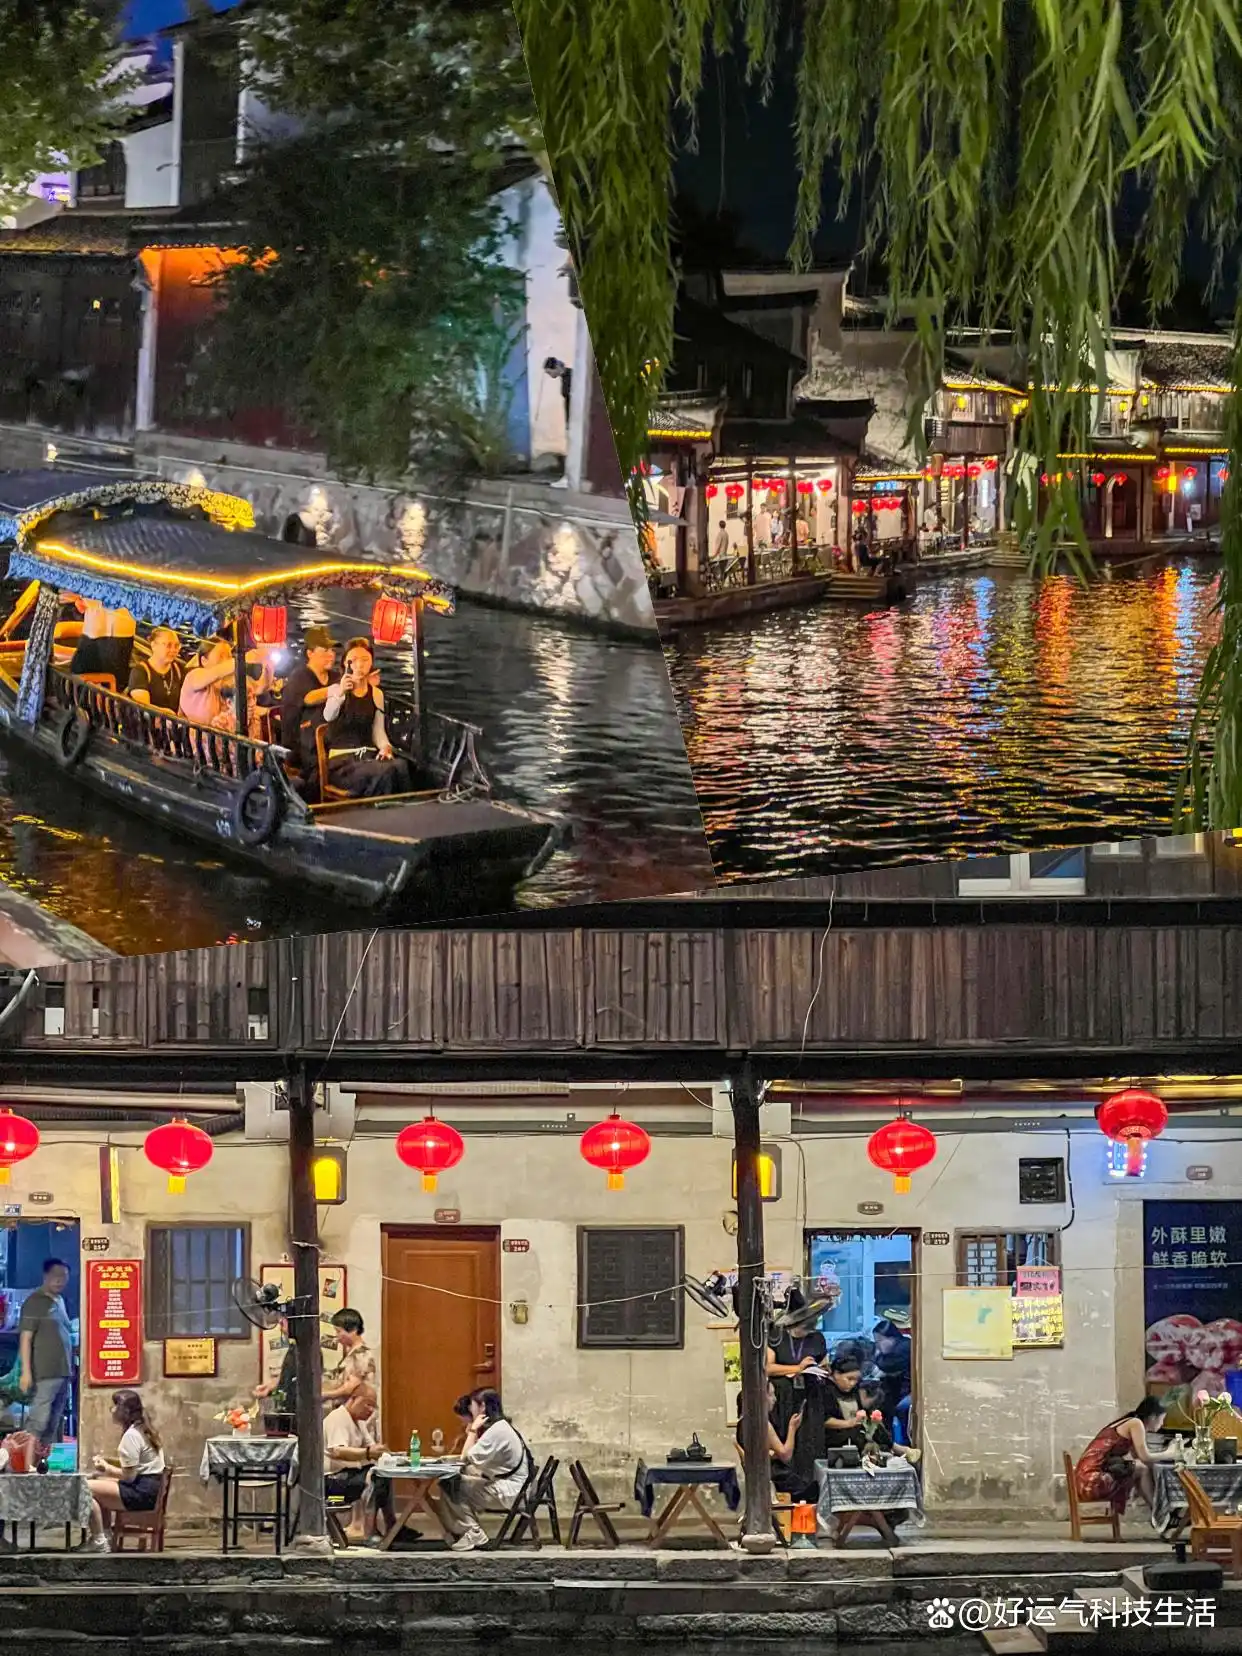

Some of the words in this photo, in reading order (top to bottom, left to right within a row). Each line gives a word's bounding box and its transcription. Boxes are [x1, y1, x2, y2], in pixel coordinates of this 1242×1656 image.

[1151, 1226, 1227, 1245] 外酥里嫩
[1152, 1250, 1228, 1269] 鲜香脆软
